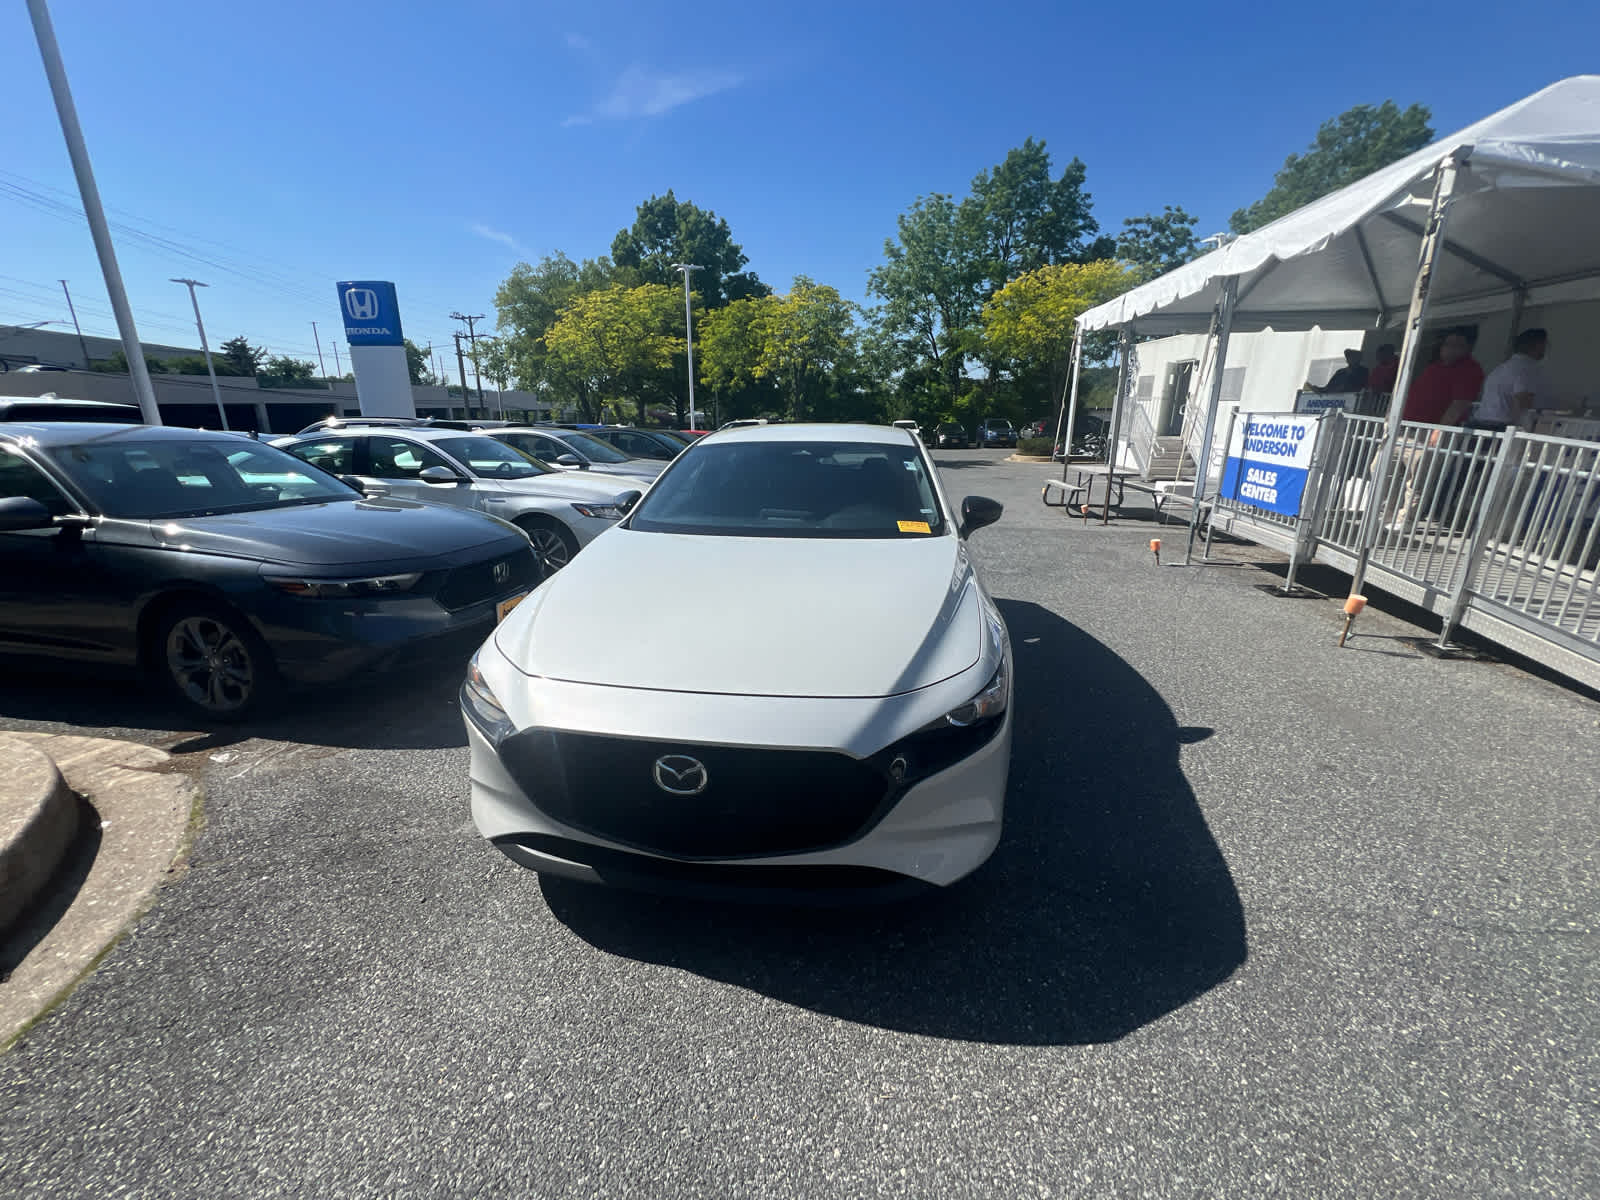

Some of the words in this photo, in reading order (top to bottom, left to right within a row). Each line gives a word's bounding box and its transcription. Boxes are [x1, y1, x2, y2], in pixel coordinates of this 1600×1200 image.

[346, 327, 391, 336] HONDA
[1291, 425, 1305, 440] TO
[1246, 467, 1278, 487] SALES
[1240, 482, 1278, 504] CENTER
